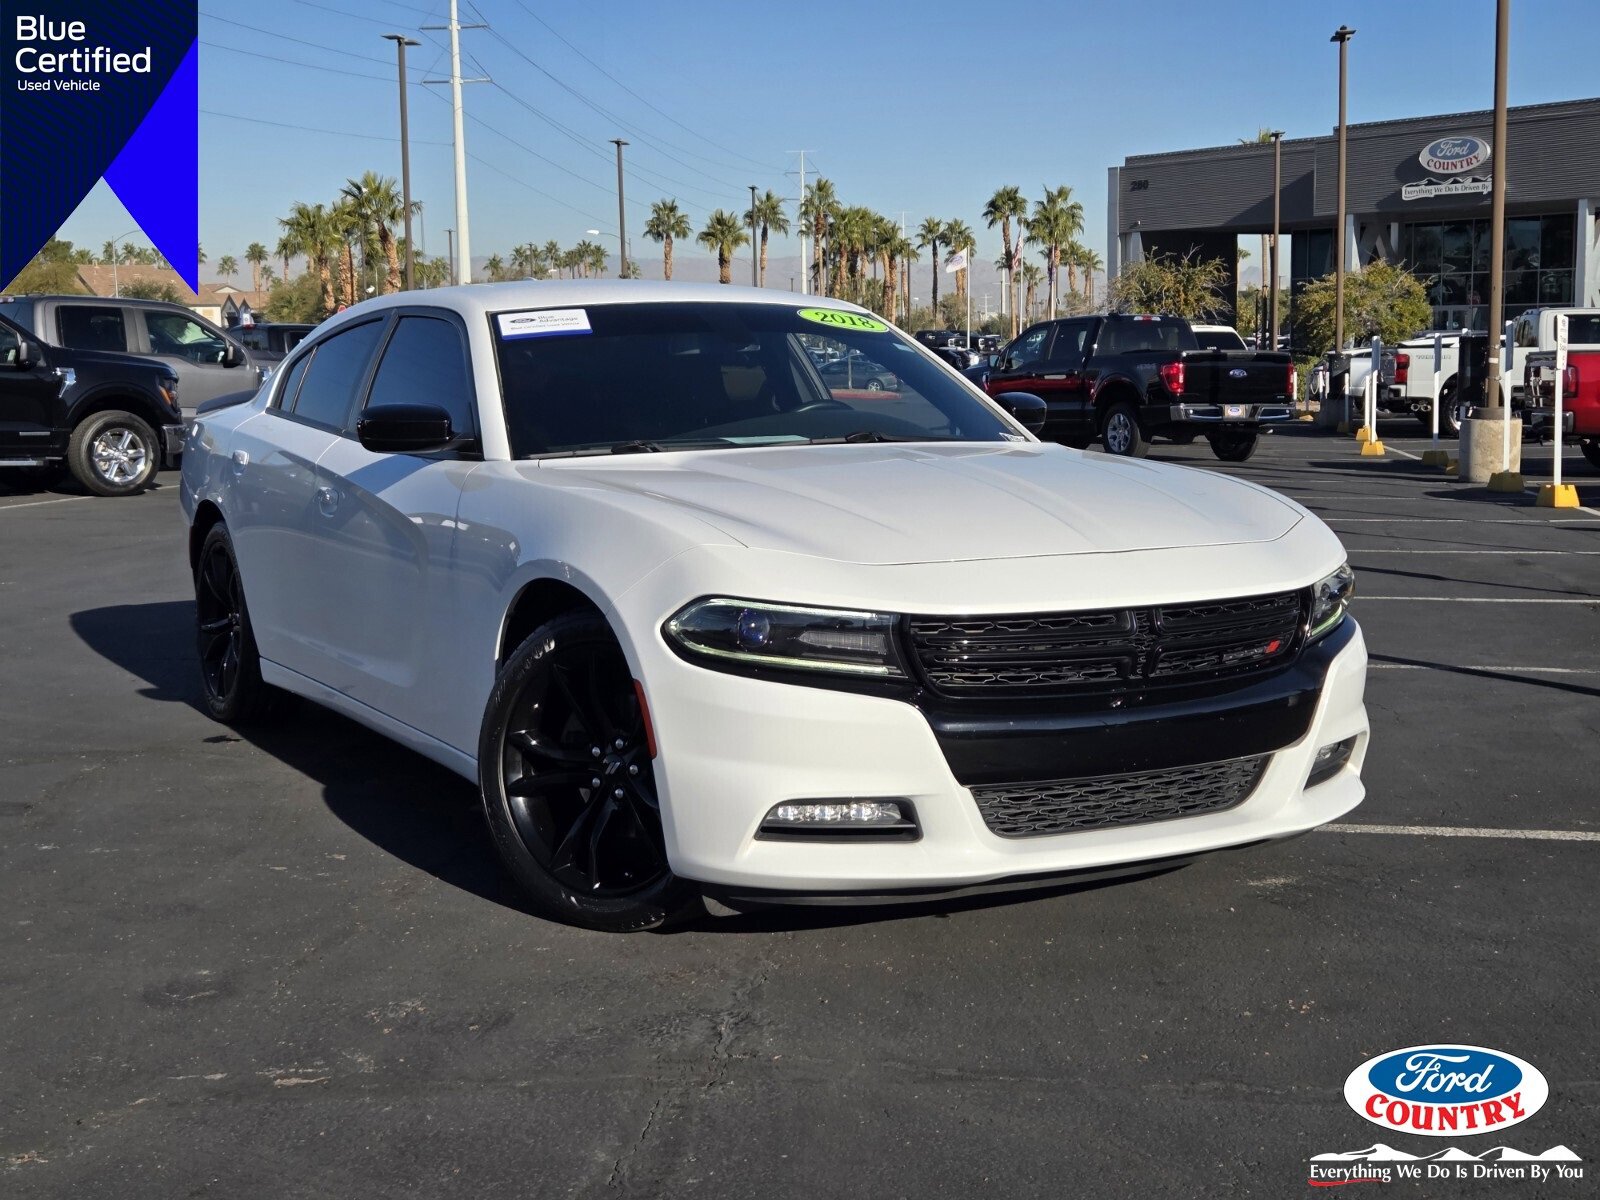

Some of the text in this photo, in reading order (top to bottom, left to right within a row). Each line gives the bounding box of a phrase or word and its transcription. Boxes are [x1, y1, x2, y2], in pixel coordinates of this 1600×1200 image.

[1436, 140, 1471, 157] Ford
[1426, 153, 1481, 171] COUNTRY
[1404, 185, 1433, 196] Everything
[1434, 186, 1444, 194] We
[1481, 183, 1490, 193] By
[814, 311, 875, 329] 2018
